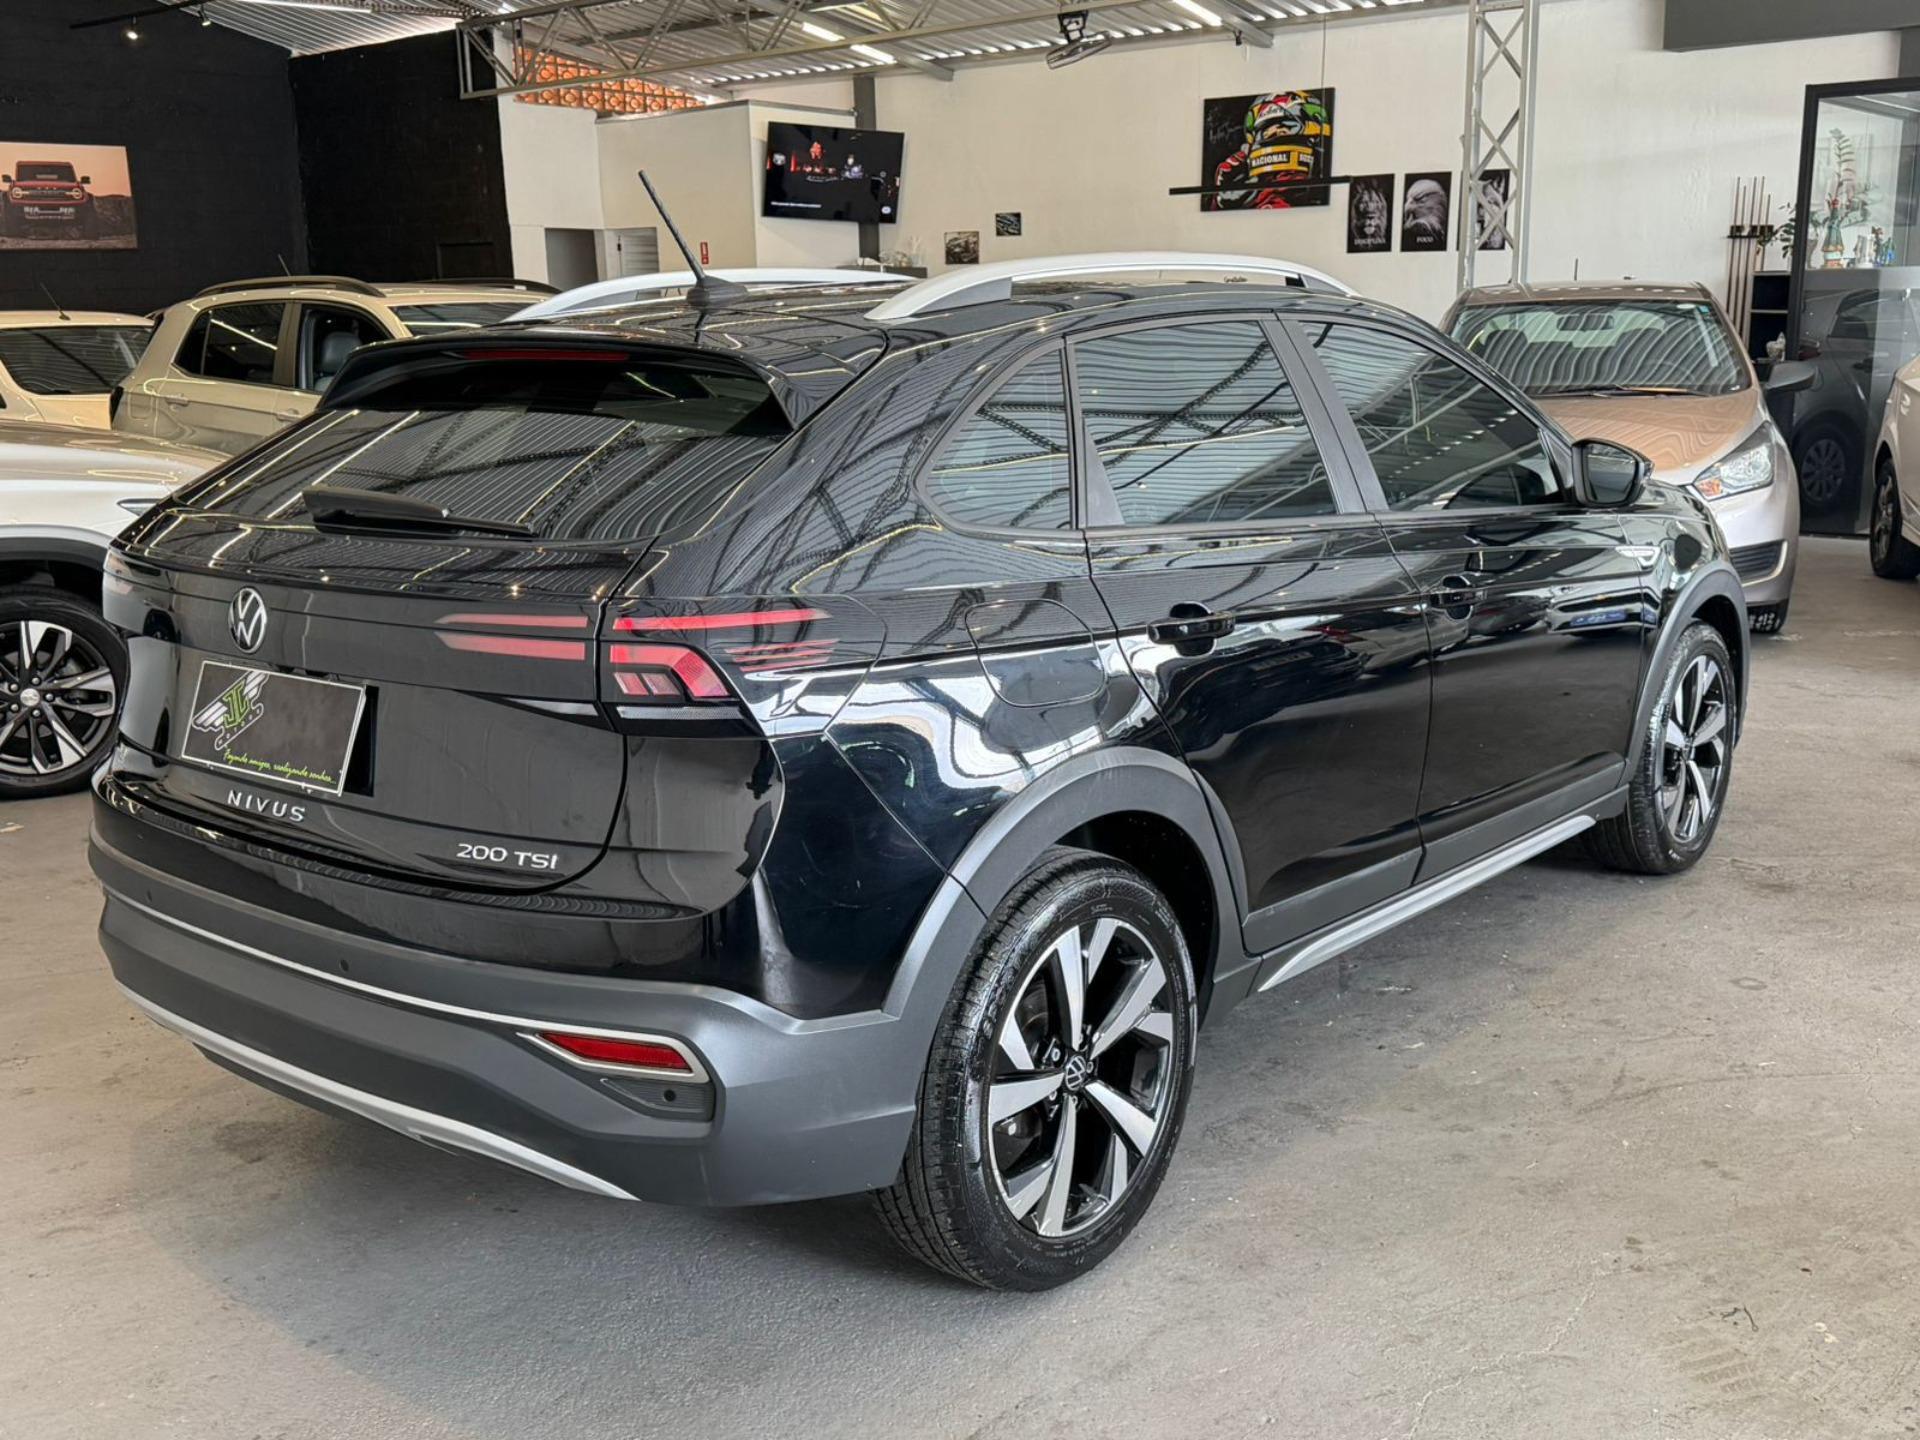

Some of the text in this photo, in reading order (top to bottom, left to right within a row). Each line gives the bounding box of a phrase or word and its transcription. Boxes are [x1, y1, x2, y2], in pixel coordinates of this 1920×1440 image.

[1252, 153, 1288, 167] NACIONAL
[228, 790, 305, 822] NIVUS
[456, 843, 558, 869] 200 TSI
